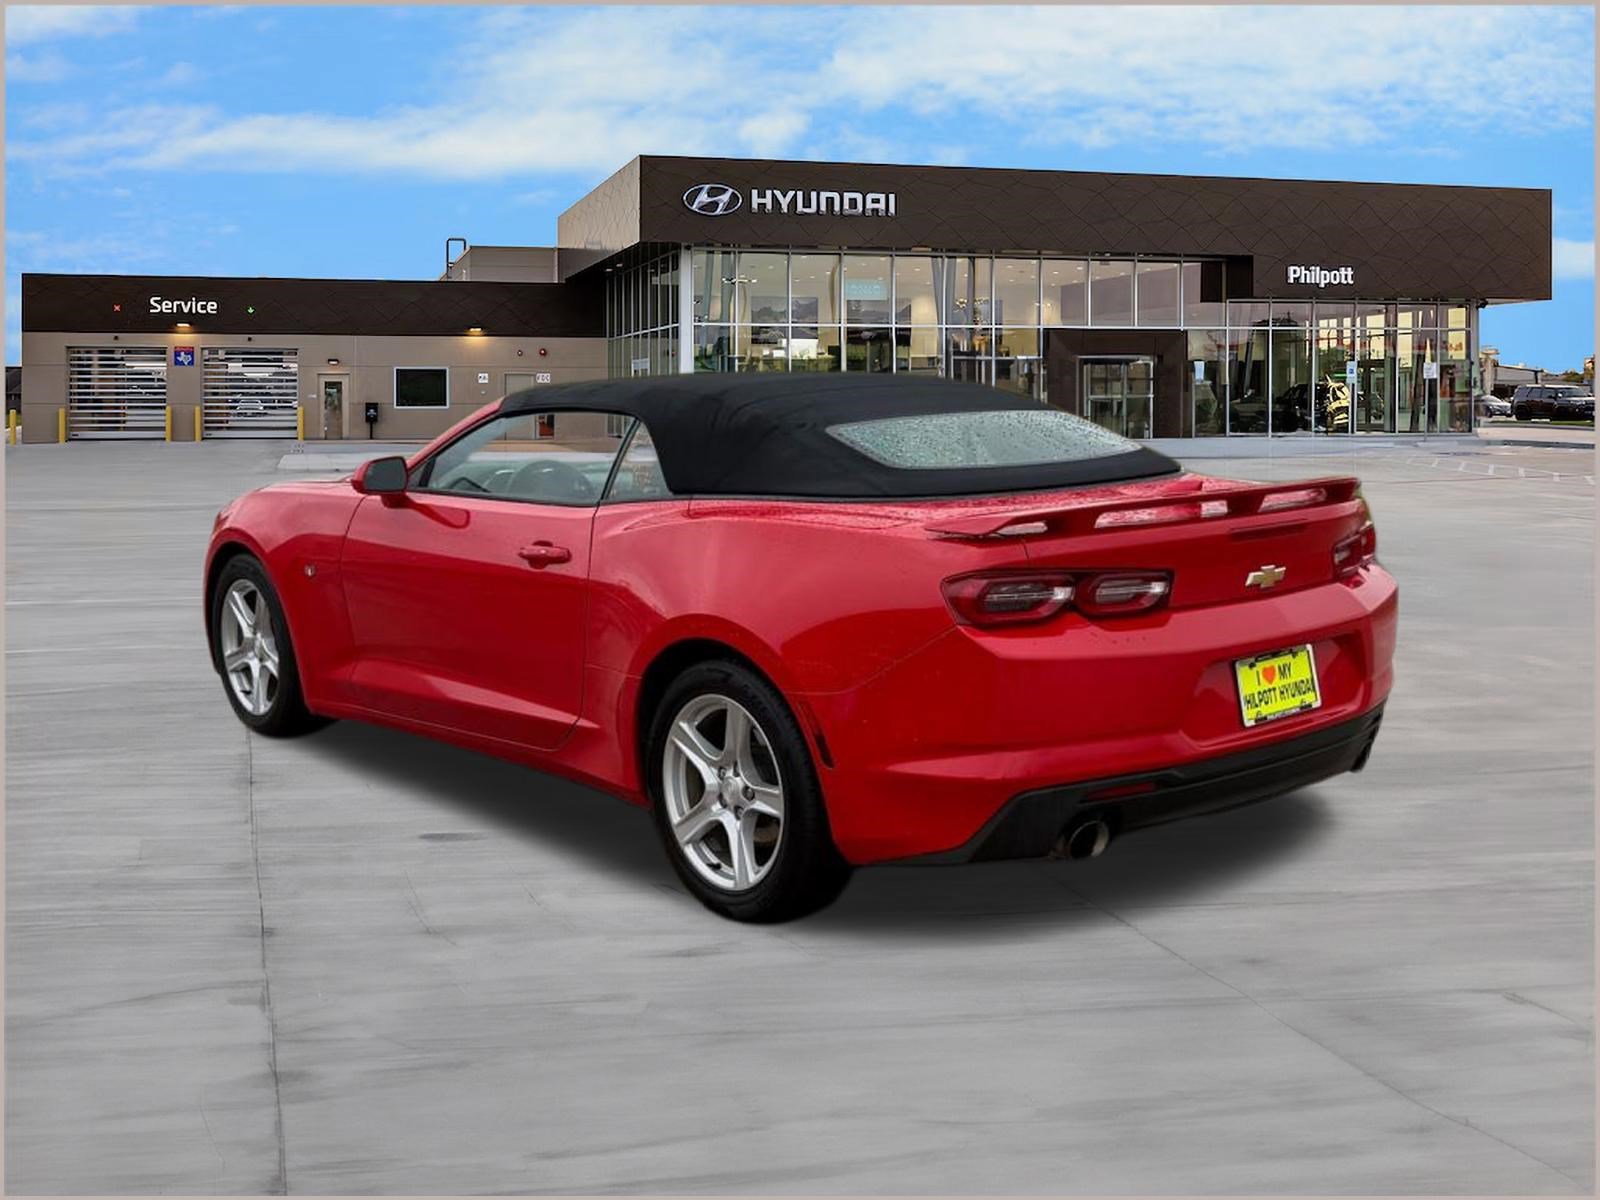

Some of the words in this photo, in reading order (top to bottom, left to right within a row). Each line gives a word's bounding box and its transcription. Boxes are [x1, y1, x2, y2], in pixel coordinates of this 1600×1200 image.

[751, 189, 896, 217] HYUNDAI
[1287, 266, 1354, 288] Philpott
[149, 296, 218, 314] Service
[1277, 662, 1292, 680] MY
